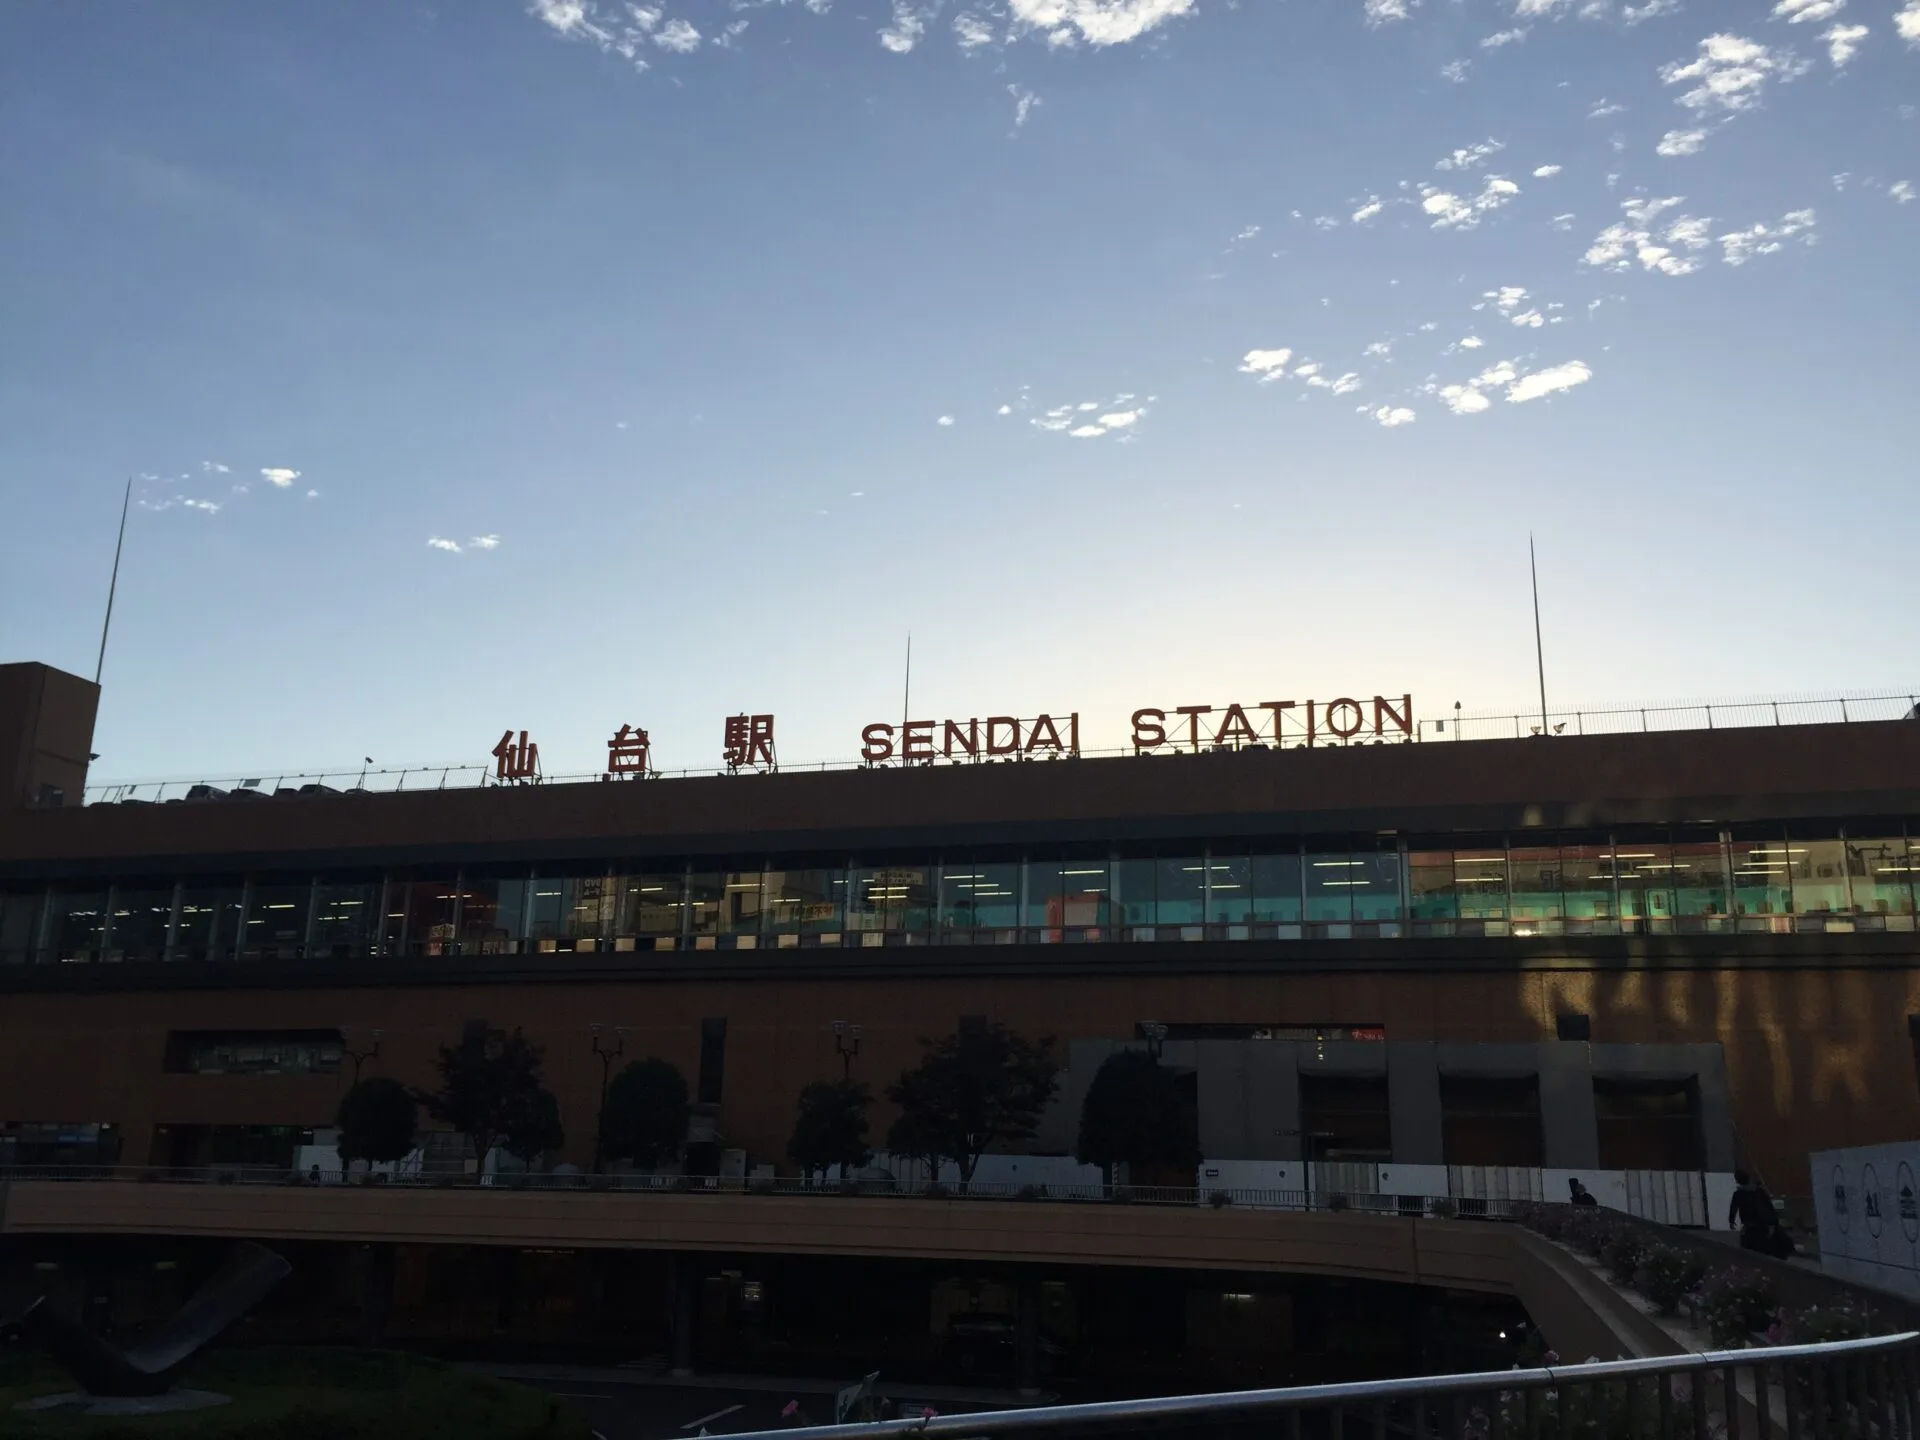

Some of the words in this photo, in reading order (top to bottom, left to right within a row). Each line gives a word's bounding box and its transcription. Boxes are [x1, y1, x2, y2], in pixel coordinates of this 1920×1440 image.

[491, 713, 775, 778] 仙台駅
[861, 712, 1079, 761] SENDAI
[1131, 694, 1412, 748] STATION
